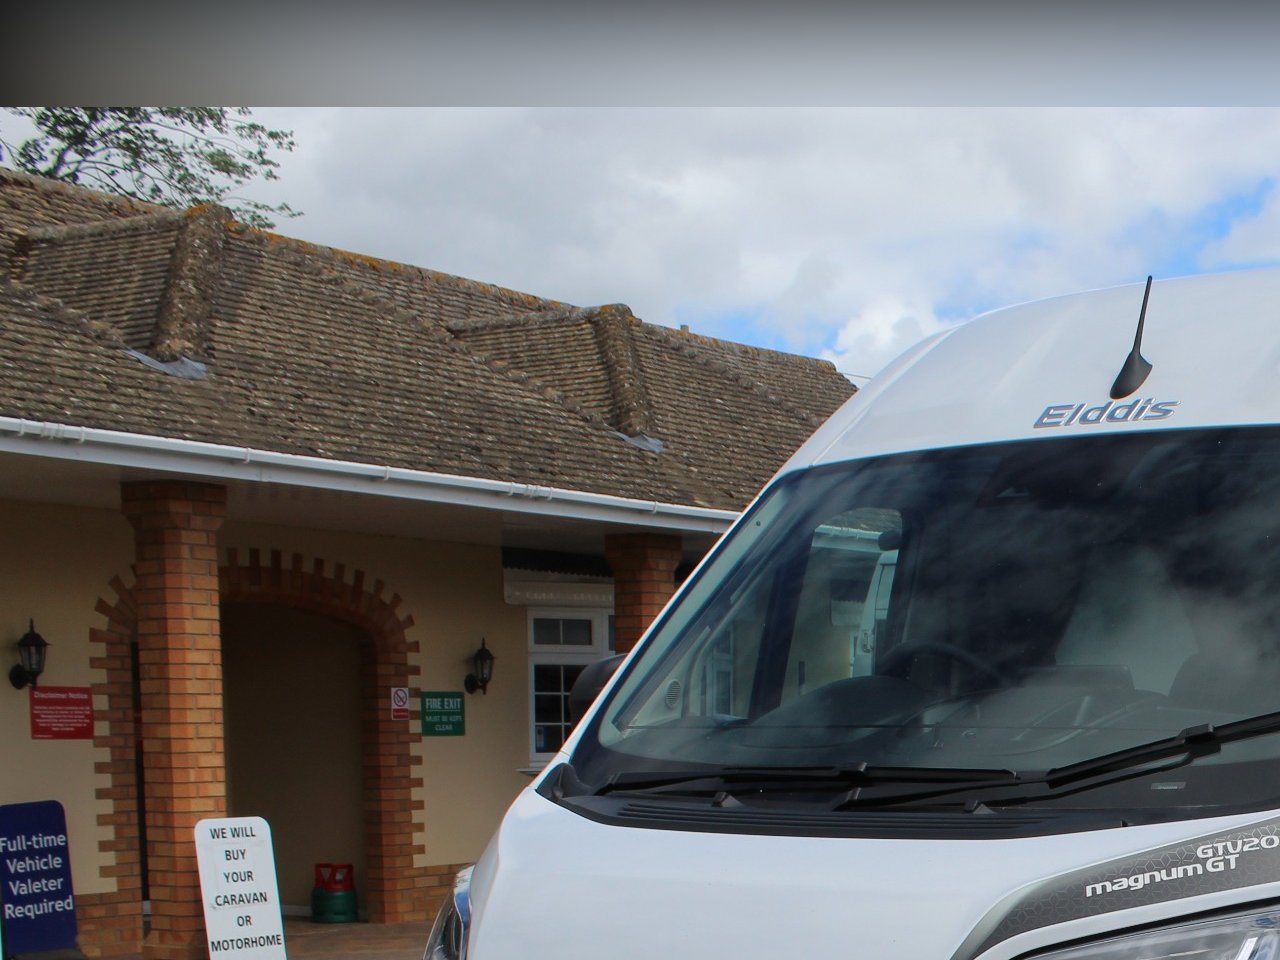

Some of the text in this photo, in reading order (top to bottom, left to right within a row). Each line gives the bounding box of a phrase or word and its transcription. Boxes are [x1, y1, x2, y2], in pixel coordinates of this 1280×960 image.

[1033, 397, 1181, 429] Elddis
[425, 697, 462, 710] FIRE EXIT
[210, 826, 256, 839] WE WILL
[0, 833, 66, 852] Full-time
[6, 854, 62, 874] Vehicle
[224, 849, 246, 861] BUY
[223, 870, 254, 883] YOUR
[1085, 854, 1240, 897] magnum GT
[9, 878, 64, 896] Valeter
[4, 895, 73, 919] Required
[215, 892, 268, 906] CARAVAN
[236, 915, 253, 927] OR
[210, 934, 282, 952] MOTORHOME
